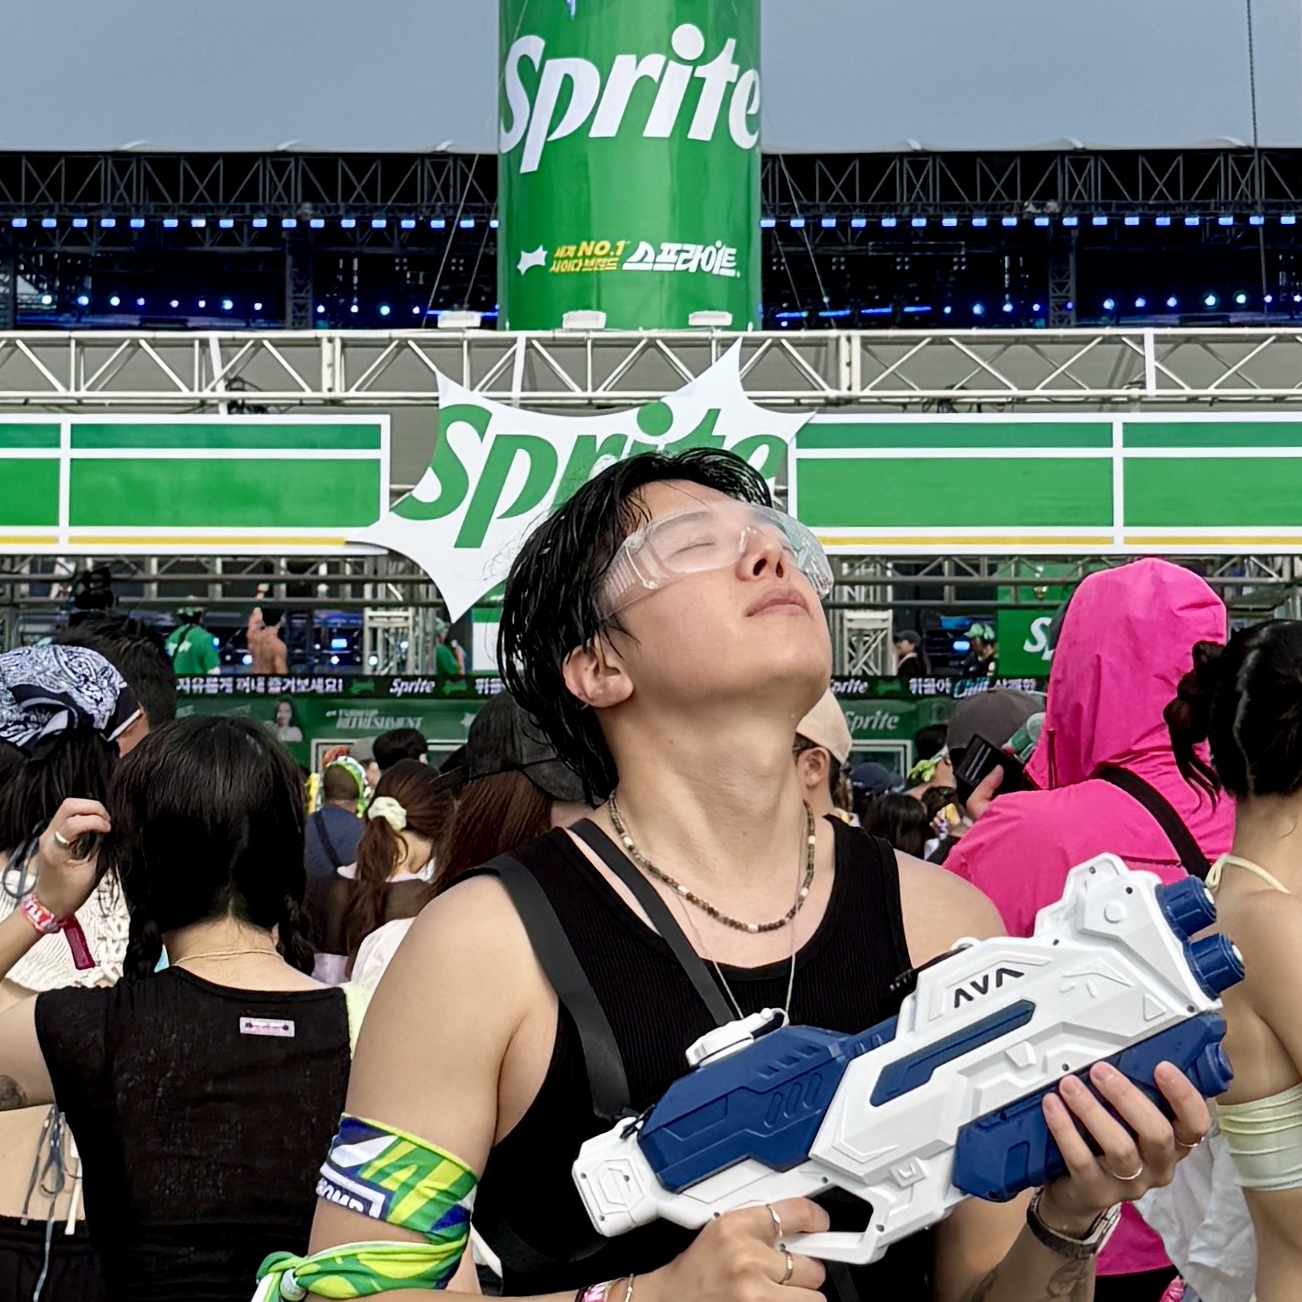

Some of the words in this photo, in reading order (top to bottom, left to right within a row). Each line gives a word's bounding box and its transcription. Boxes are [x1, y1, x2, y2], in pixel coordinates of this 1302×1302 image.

[499, 23, 761, 174] Sprite
[578, 240, 626, 257] NO.1
[549, 258, 582, 273] 사이다
[622, 240, 737, 277] 스프라이트
[389, 677, 436, 696] Sprite
